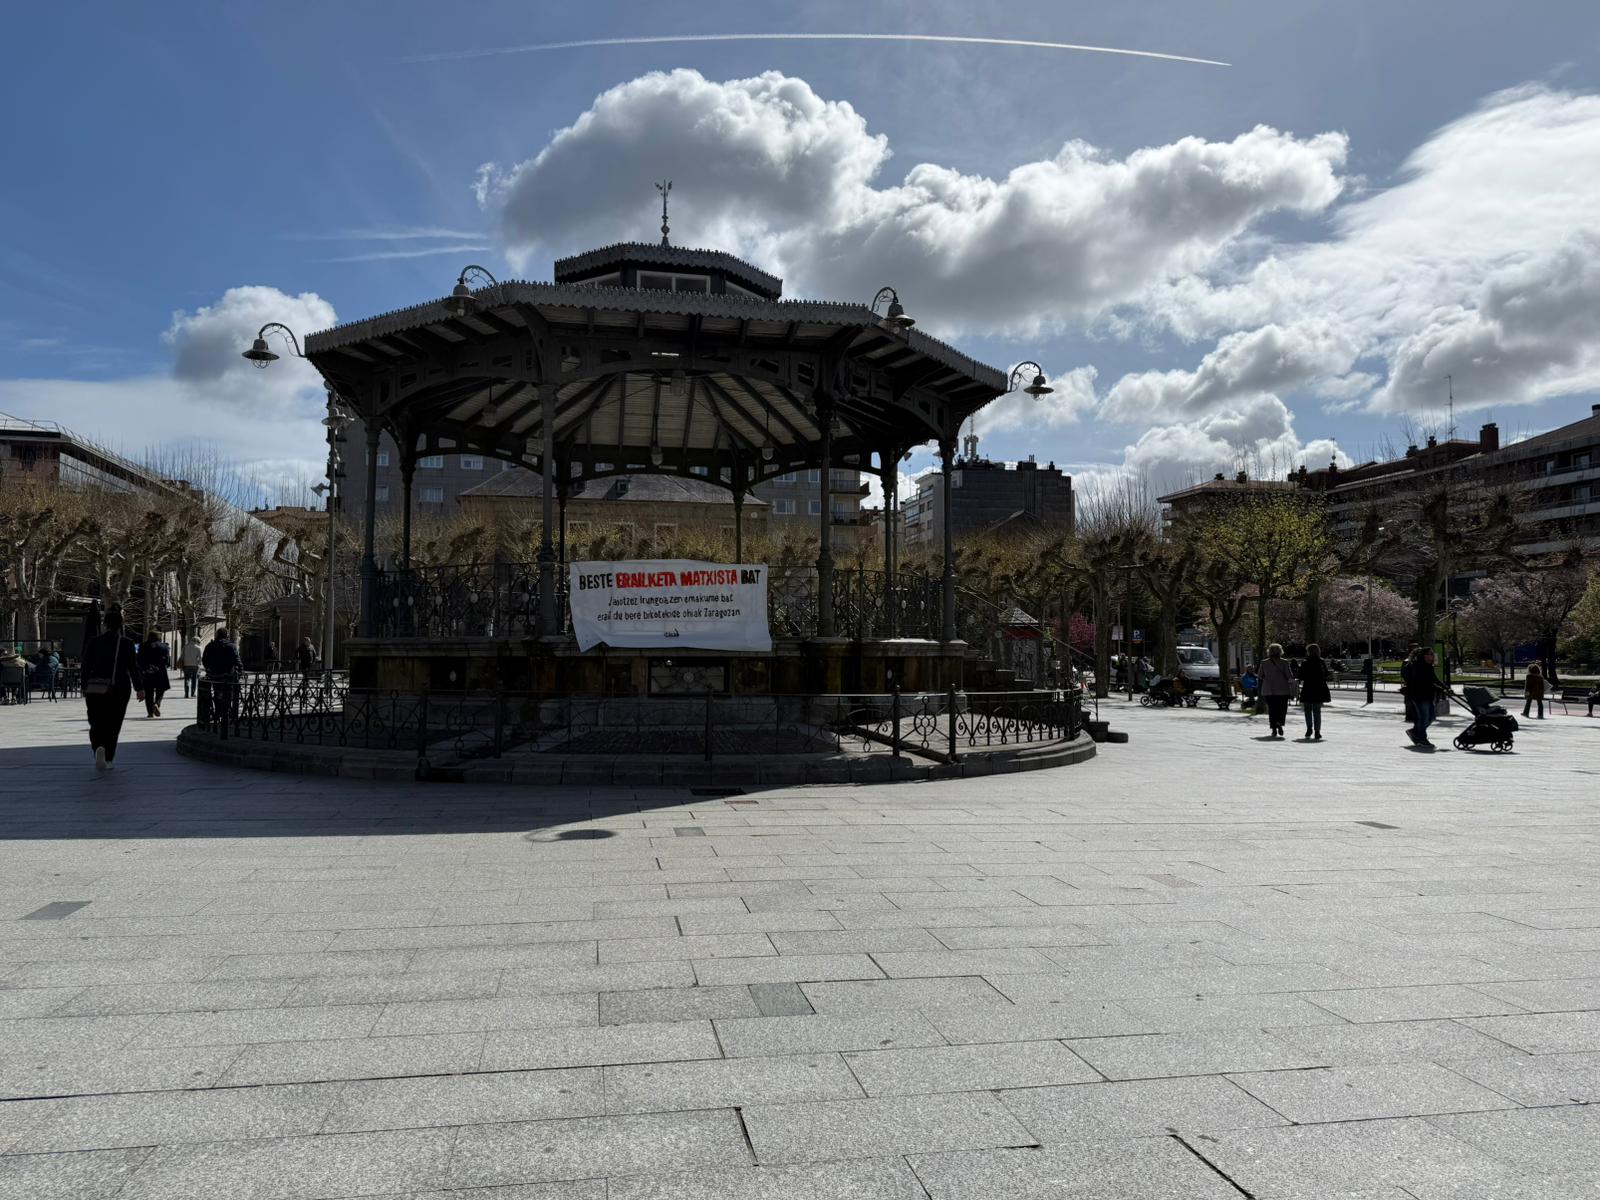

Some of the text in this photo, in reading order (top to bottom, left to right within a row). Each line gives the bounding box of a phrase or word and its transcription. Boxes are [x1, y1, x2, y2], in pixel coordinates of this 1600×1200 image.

[579, 569, 761, 590] BESTE ERAILKETA MATXISTA BAT
[684, 594, 719, 604] emakume
[720, 593, 734, 603] bat
[597, 613, 612, 622] erail
[613, 611, 623, 621] du
[624, 611, 642, 620] bere
[704, 607, 741, 619] Zaragozan
[1133, 630, 1140, 638] P
